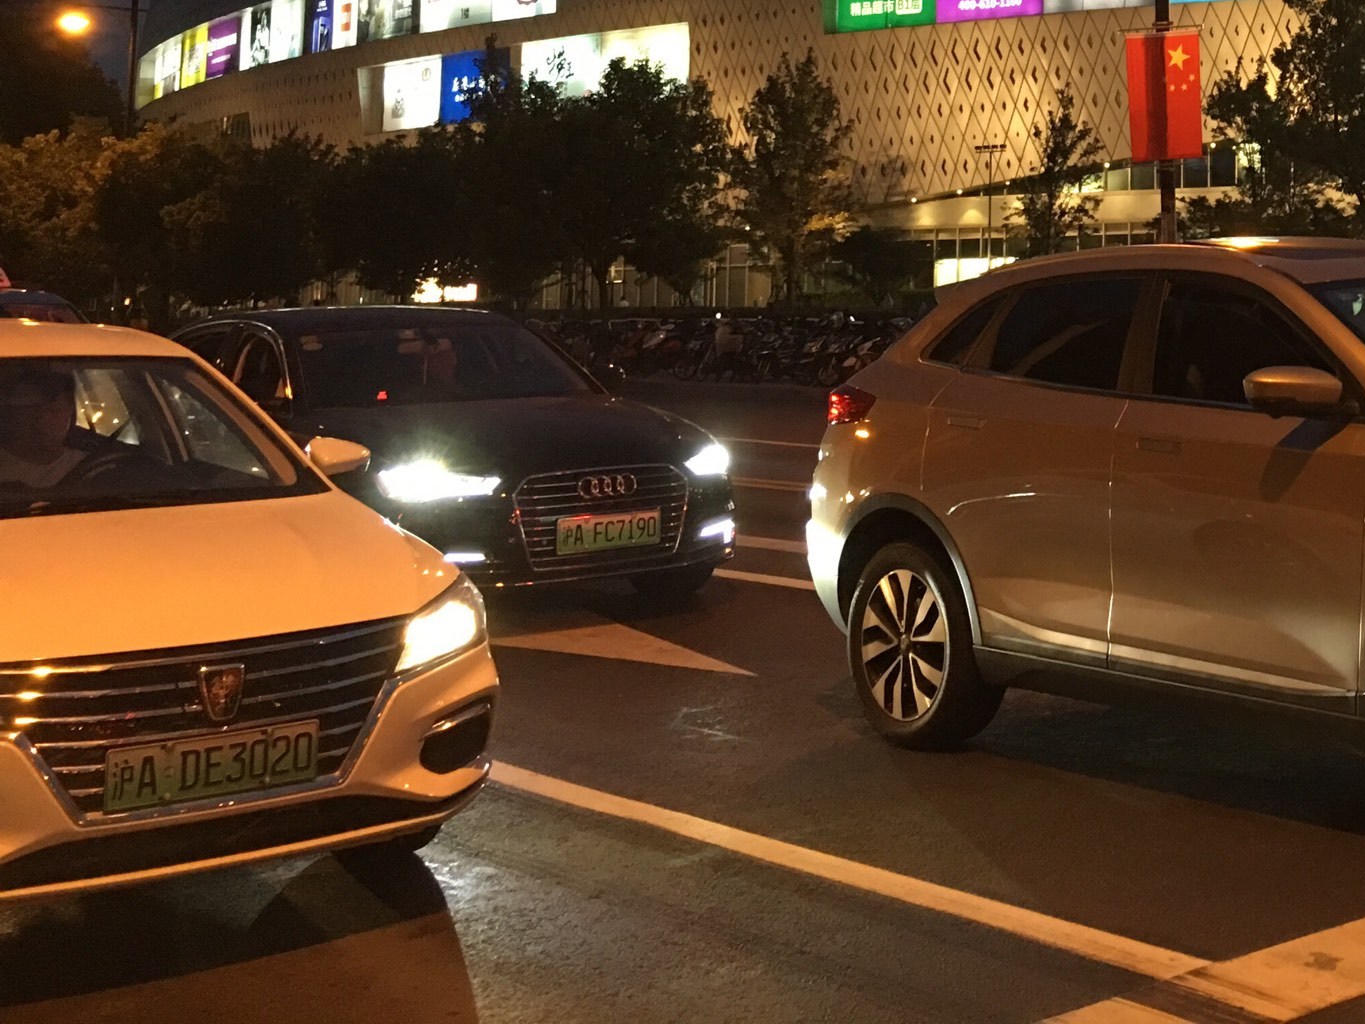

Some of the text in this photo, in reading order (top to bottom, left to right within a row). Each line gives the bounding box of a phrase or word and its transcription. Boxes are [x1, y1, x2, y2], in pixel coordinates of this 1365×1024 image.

[850, 0, 894, 17] 精品超市
[593, 516, 656, 543] FC7190
[112, 732, 313, 801] 沪A DE3020
